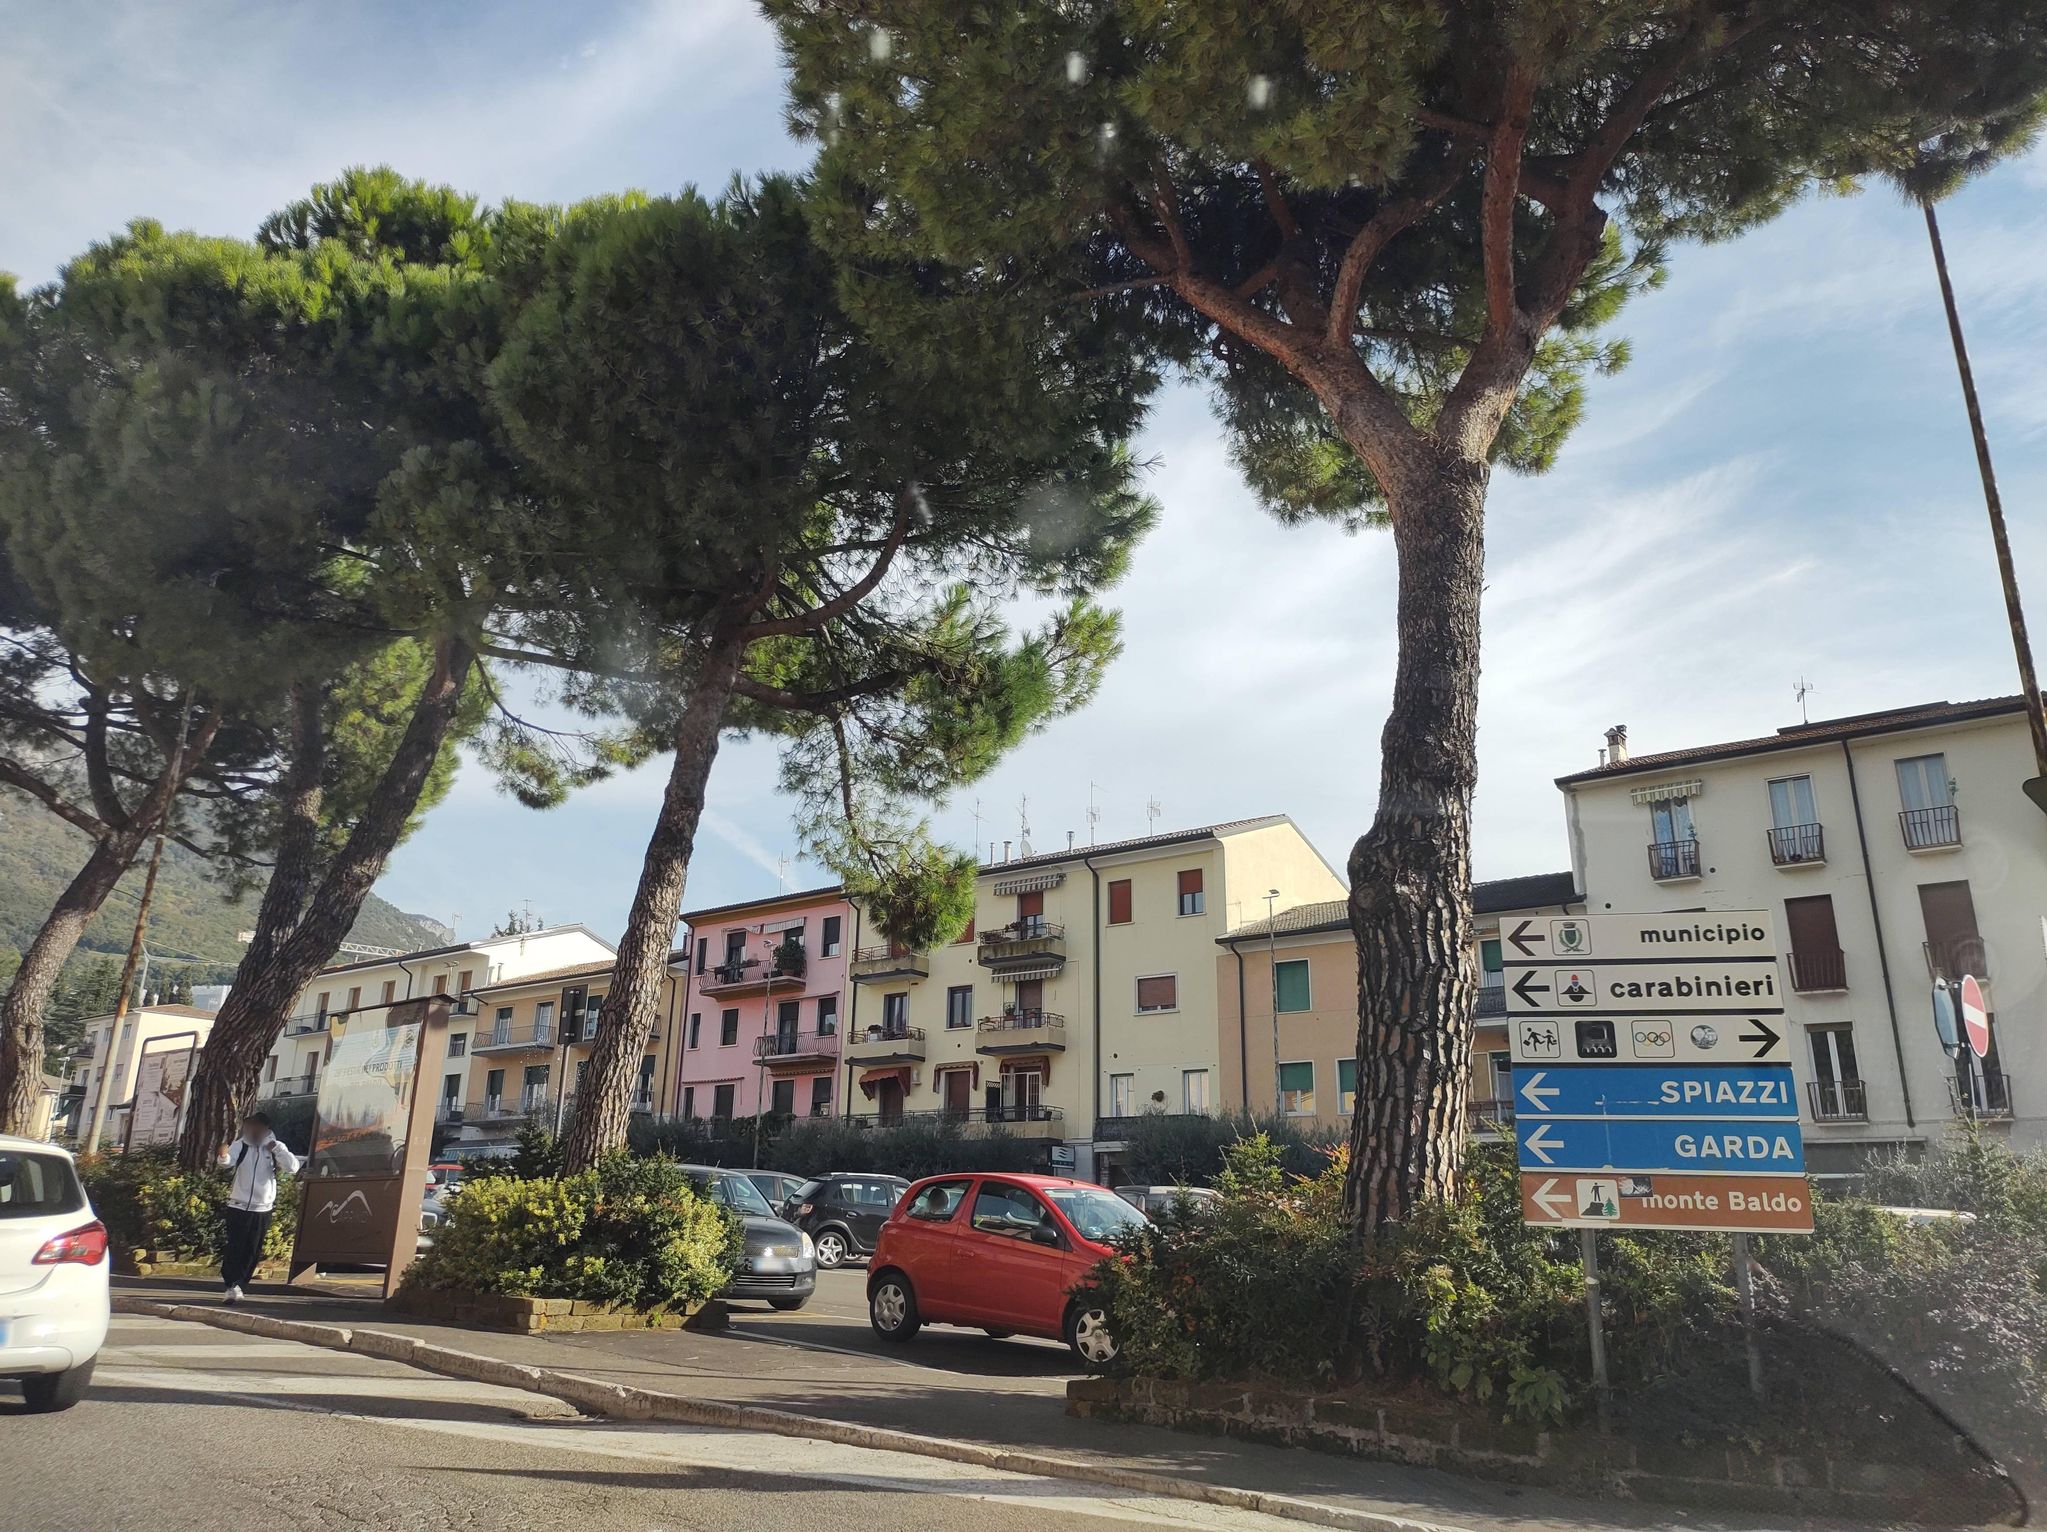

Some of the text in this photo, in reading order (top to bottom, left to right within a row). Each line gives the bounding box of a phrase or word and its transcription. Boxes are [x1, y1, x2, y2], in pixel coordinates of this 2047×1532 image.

[1640, 922, 1765, 945] municipio
[1610, 975, 1774, 998] carabinieri
[1659, 1080, 1789, 1105] SPIAZZI
[1674, 1134, 1795, 1160] GARDA
[1641, 1190, 1802, 1213] monte Baldo
